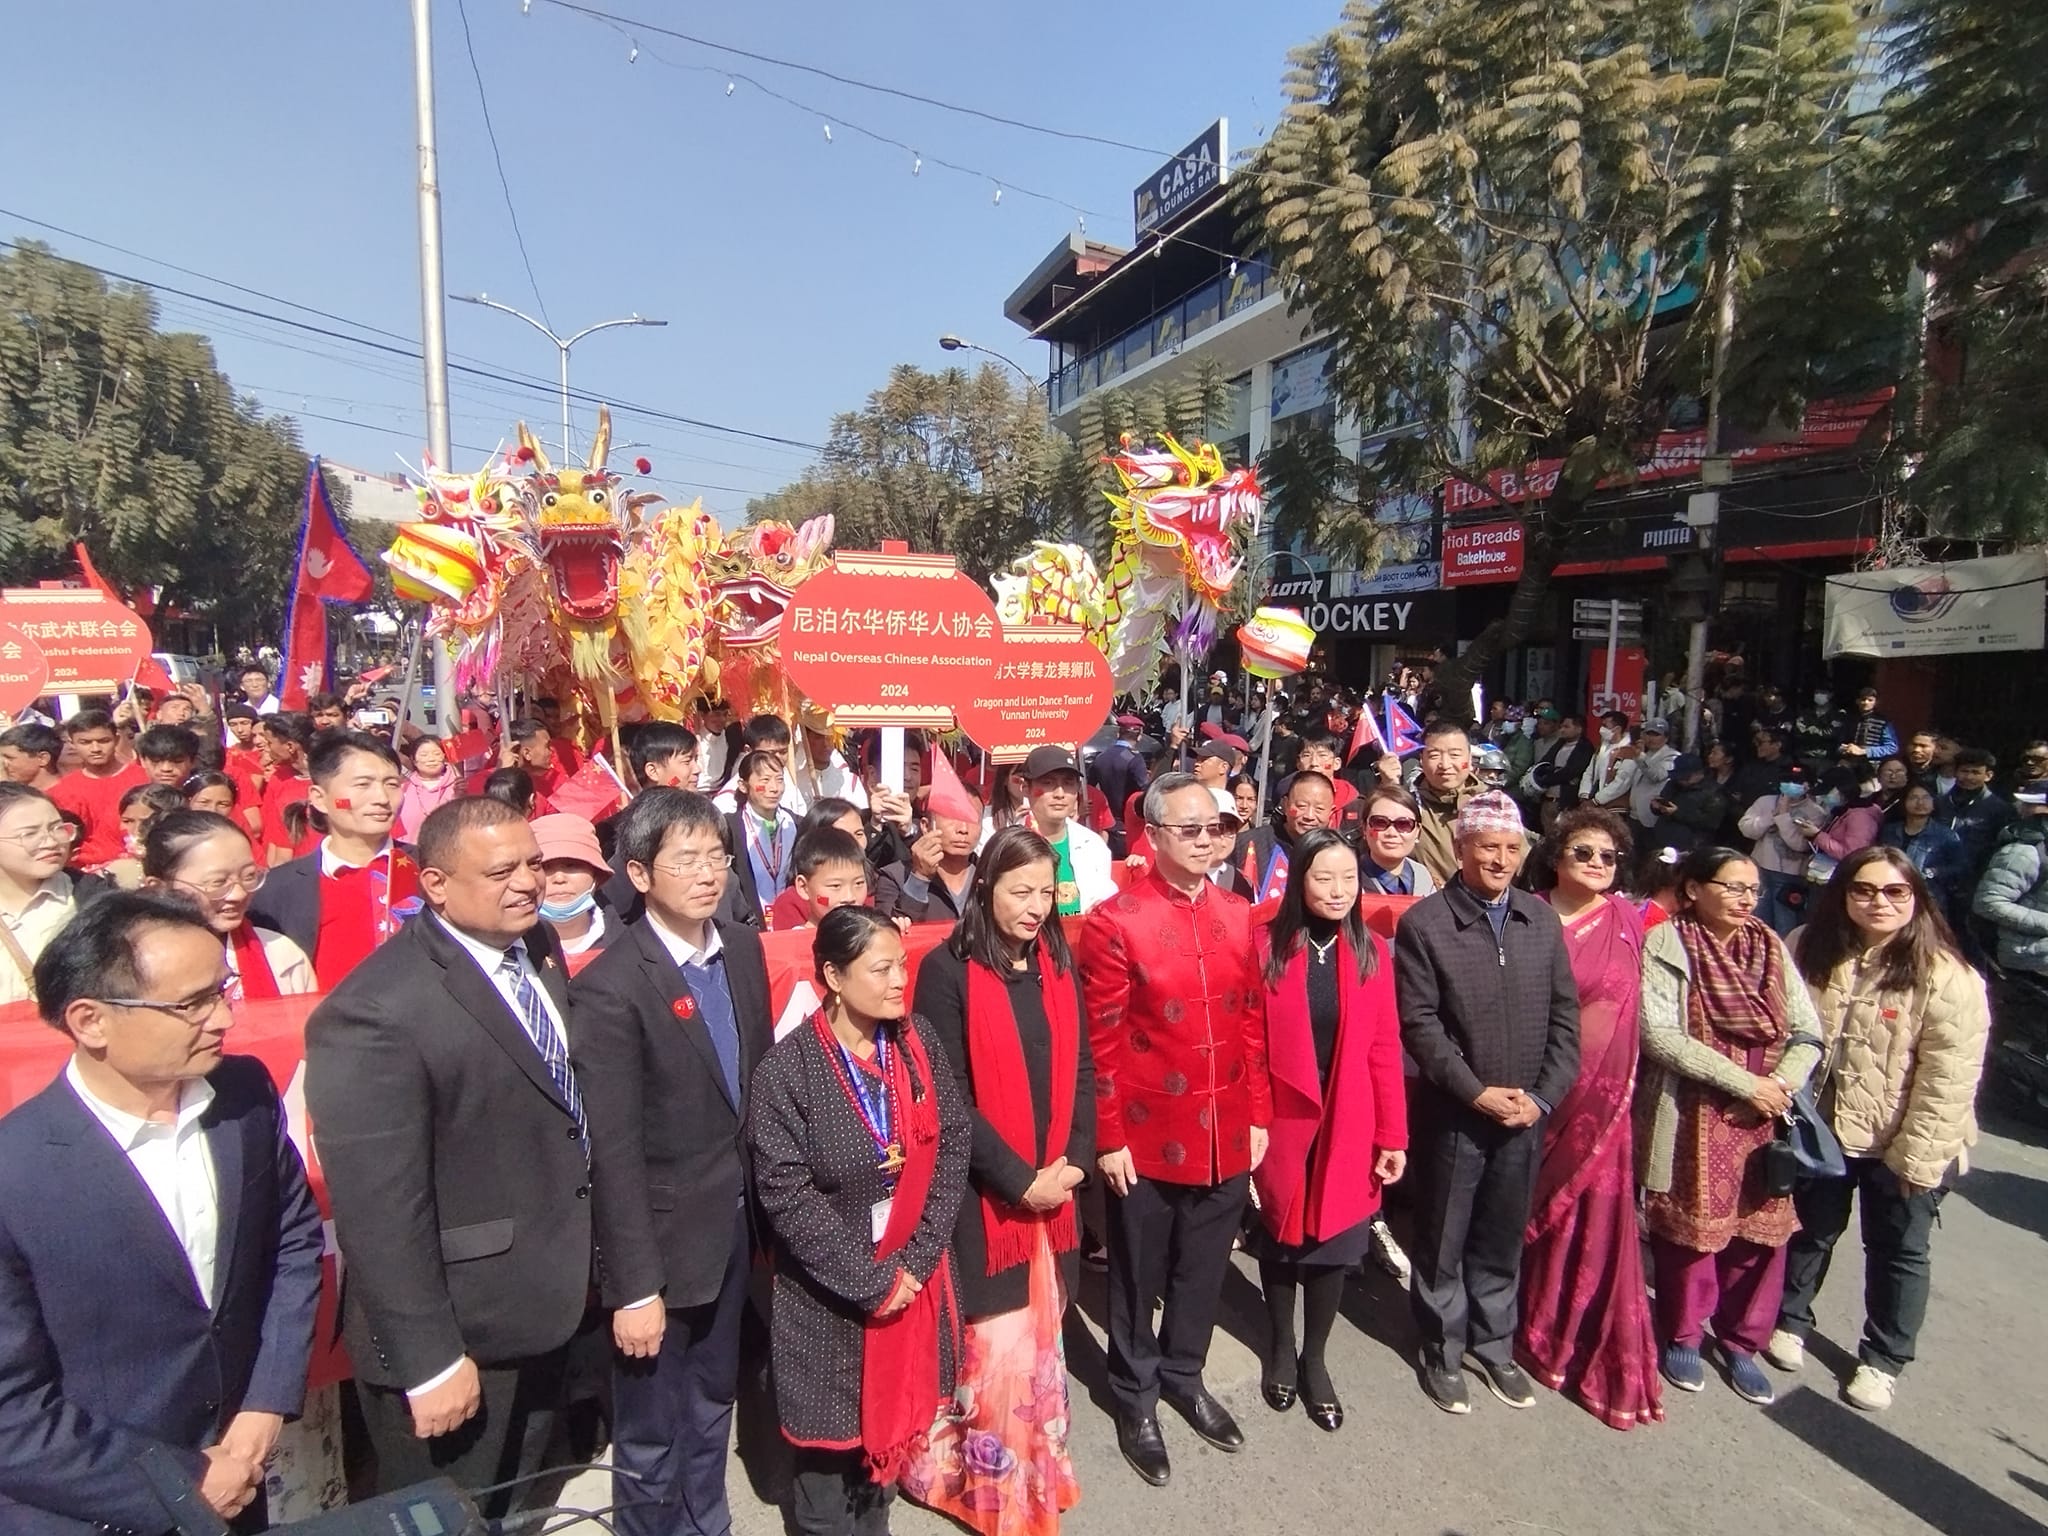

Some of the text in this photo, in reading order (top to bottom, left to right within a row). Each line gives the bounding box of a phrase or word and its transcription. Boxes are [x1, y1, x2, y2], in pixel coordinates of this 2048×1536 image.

[1160, 142, 1211, 199] CASA
[1160, 166, 1217, 217] LOUNGE BAR
[1447, 527, 1520, 549] Hot Breads
[1643, 527, 1690, 548] PUMA
[1457, 550, 1506, 565] BakeHouse
[1271, 579, 1324, 597] LOTTO
[8, 619, 137, 639] 尔武术联合会
[793, 607, 994, 639] 尼泊尔华侨华人协会
[2, 641, 22, 659] 会
[41, 646, 132, 657] ushu Federation
[793, 651, 992, 666] Nepal Overseas Chinese Association
[54, 668, 78, 677] 2024
[880, 684, 909, 697] 2024
[973, 694, 1093, 710] Dragon and Lion Dance Team of
[1001, 709, 1069, 720] Yunnan University
[1025, 728, 1046, 738] 2024
